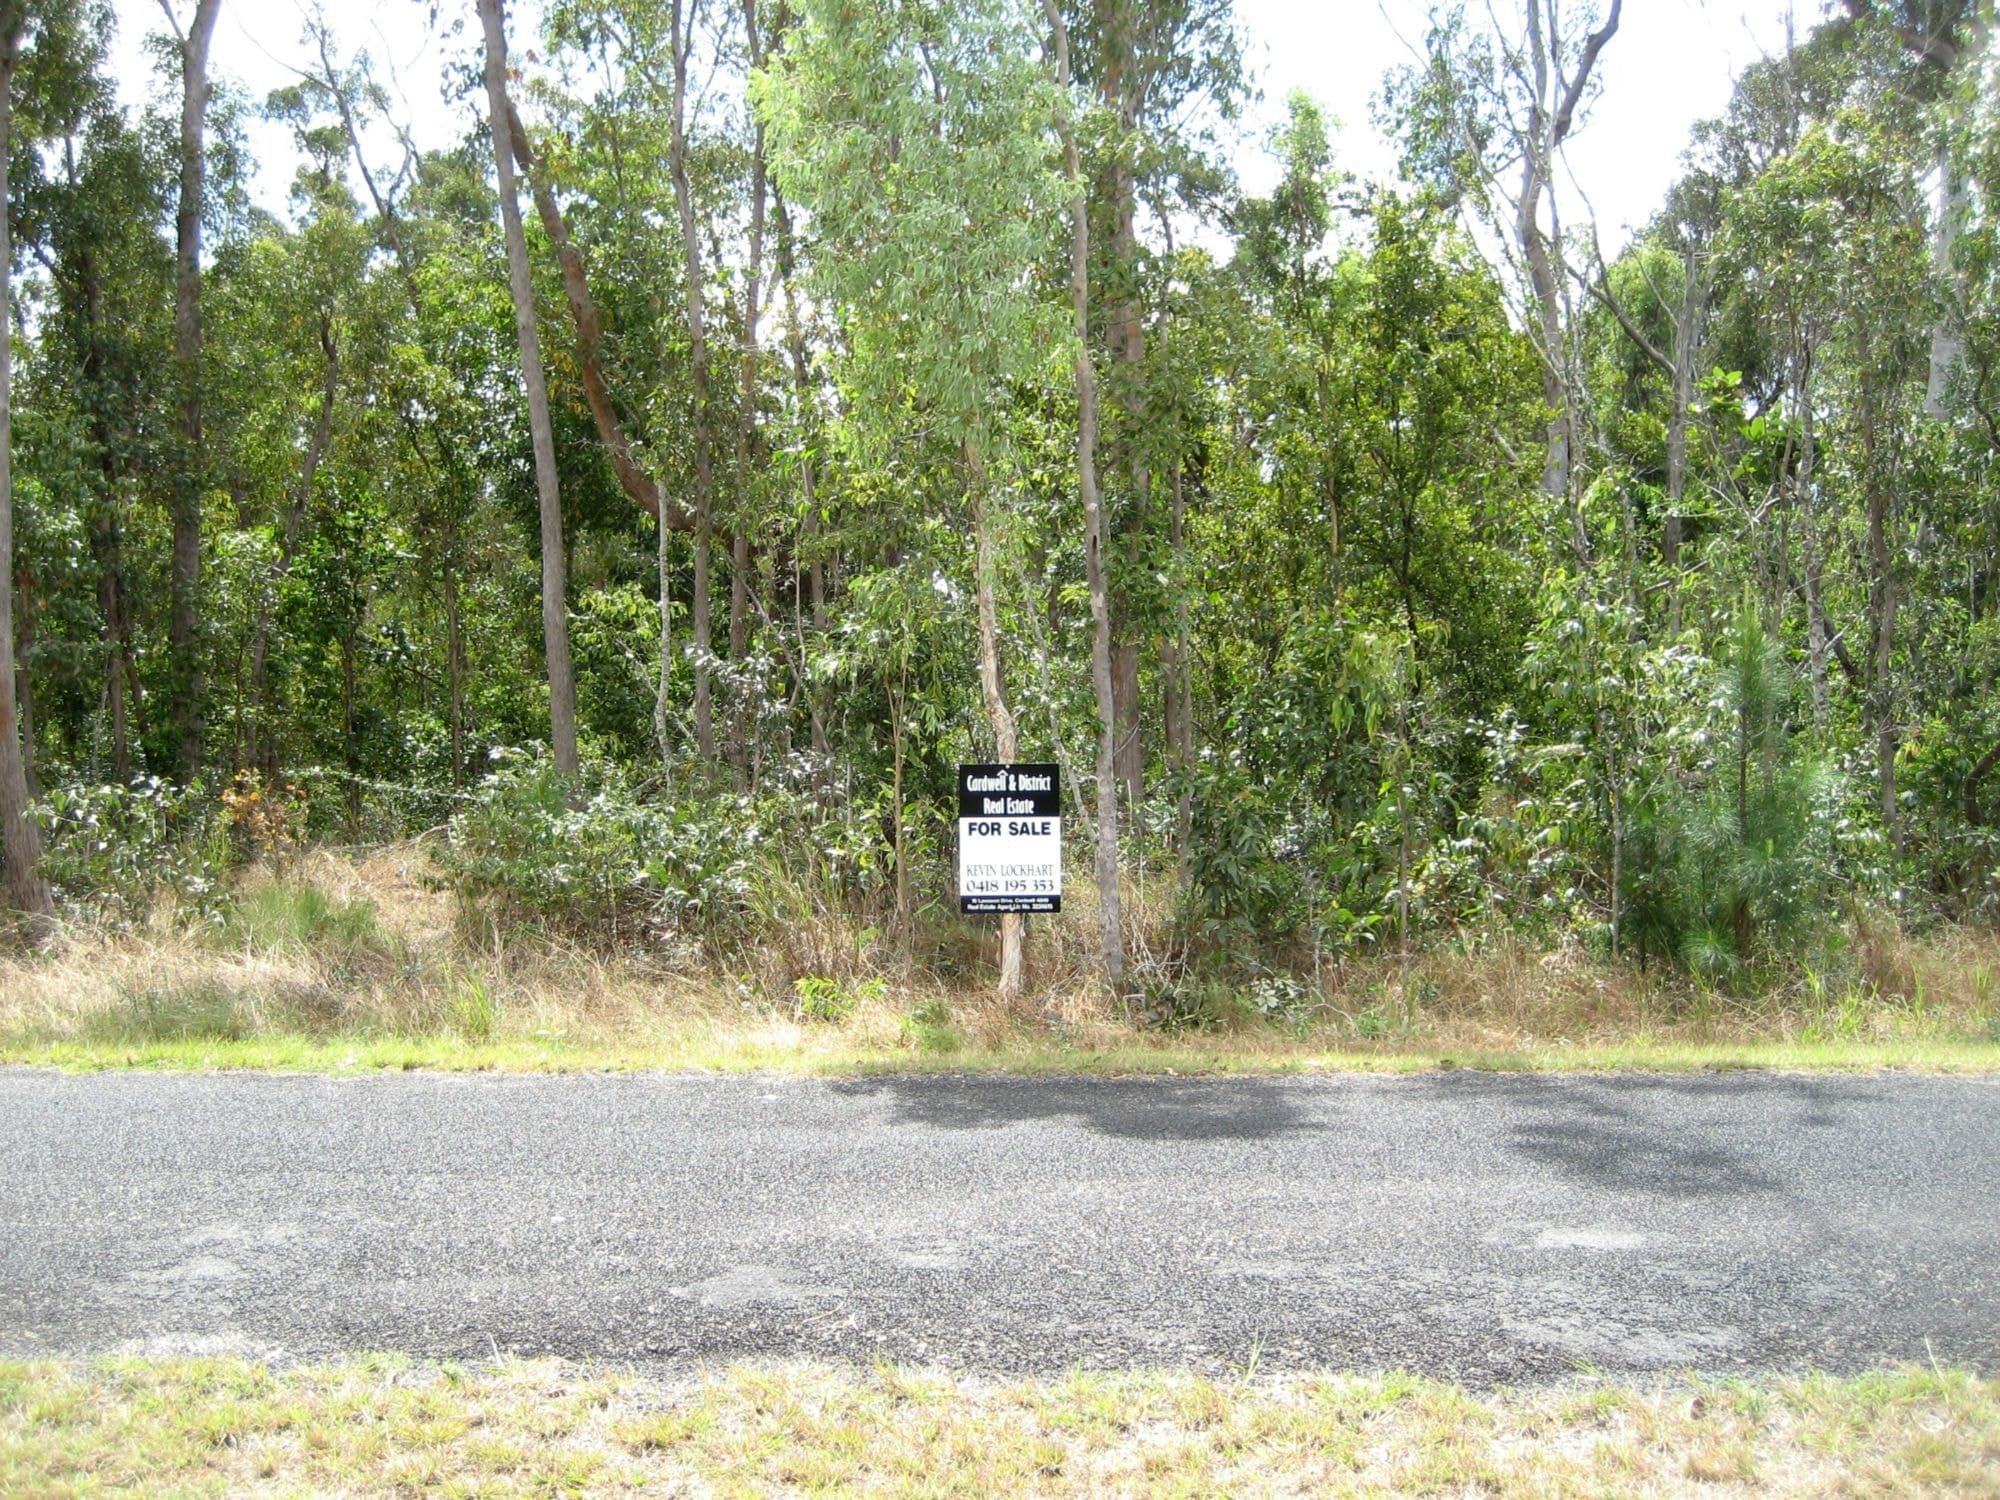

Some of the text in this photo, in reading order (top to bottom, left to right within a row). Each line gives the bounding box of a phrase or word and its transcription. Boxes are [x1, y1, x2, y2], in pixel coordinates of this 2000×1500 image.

[967, 774, 1051, 792] Cardwell & District
[983, 797, 1035, 814] Real Estate
[968, 822, 1051, 836] FOR SALE
[966, 864, 1054, 877] KEVIN LOCKHART
[966, 880, 999, 892] 0418
[1005, 880, 1027, 892] 195
